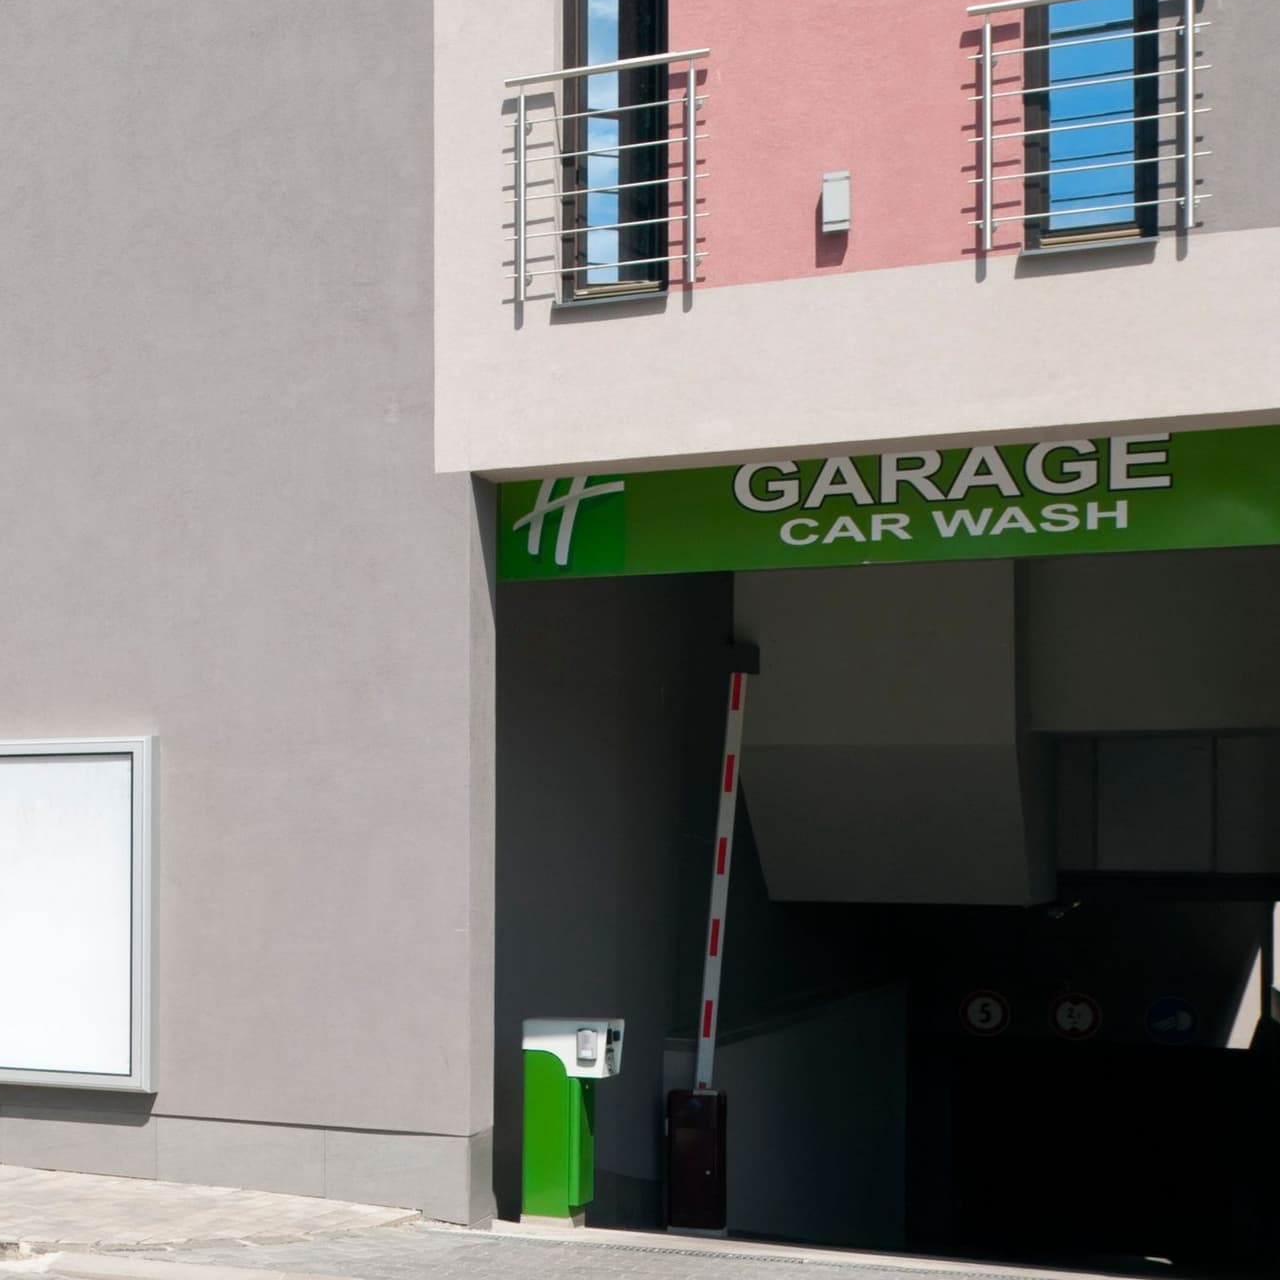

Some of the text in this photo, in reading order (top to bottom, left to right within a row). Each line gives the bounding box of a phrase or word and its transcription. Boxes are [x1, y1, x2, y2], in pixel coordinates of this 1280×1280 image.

[733, 432, 1173, 513] GARAGE
[779, 499, 1129, 546] CAR WASH
[980, 1003, 992, 1023] 5
